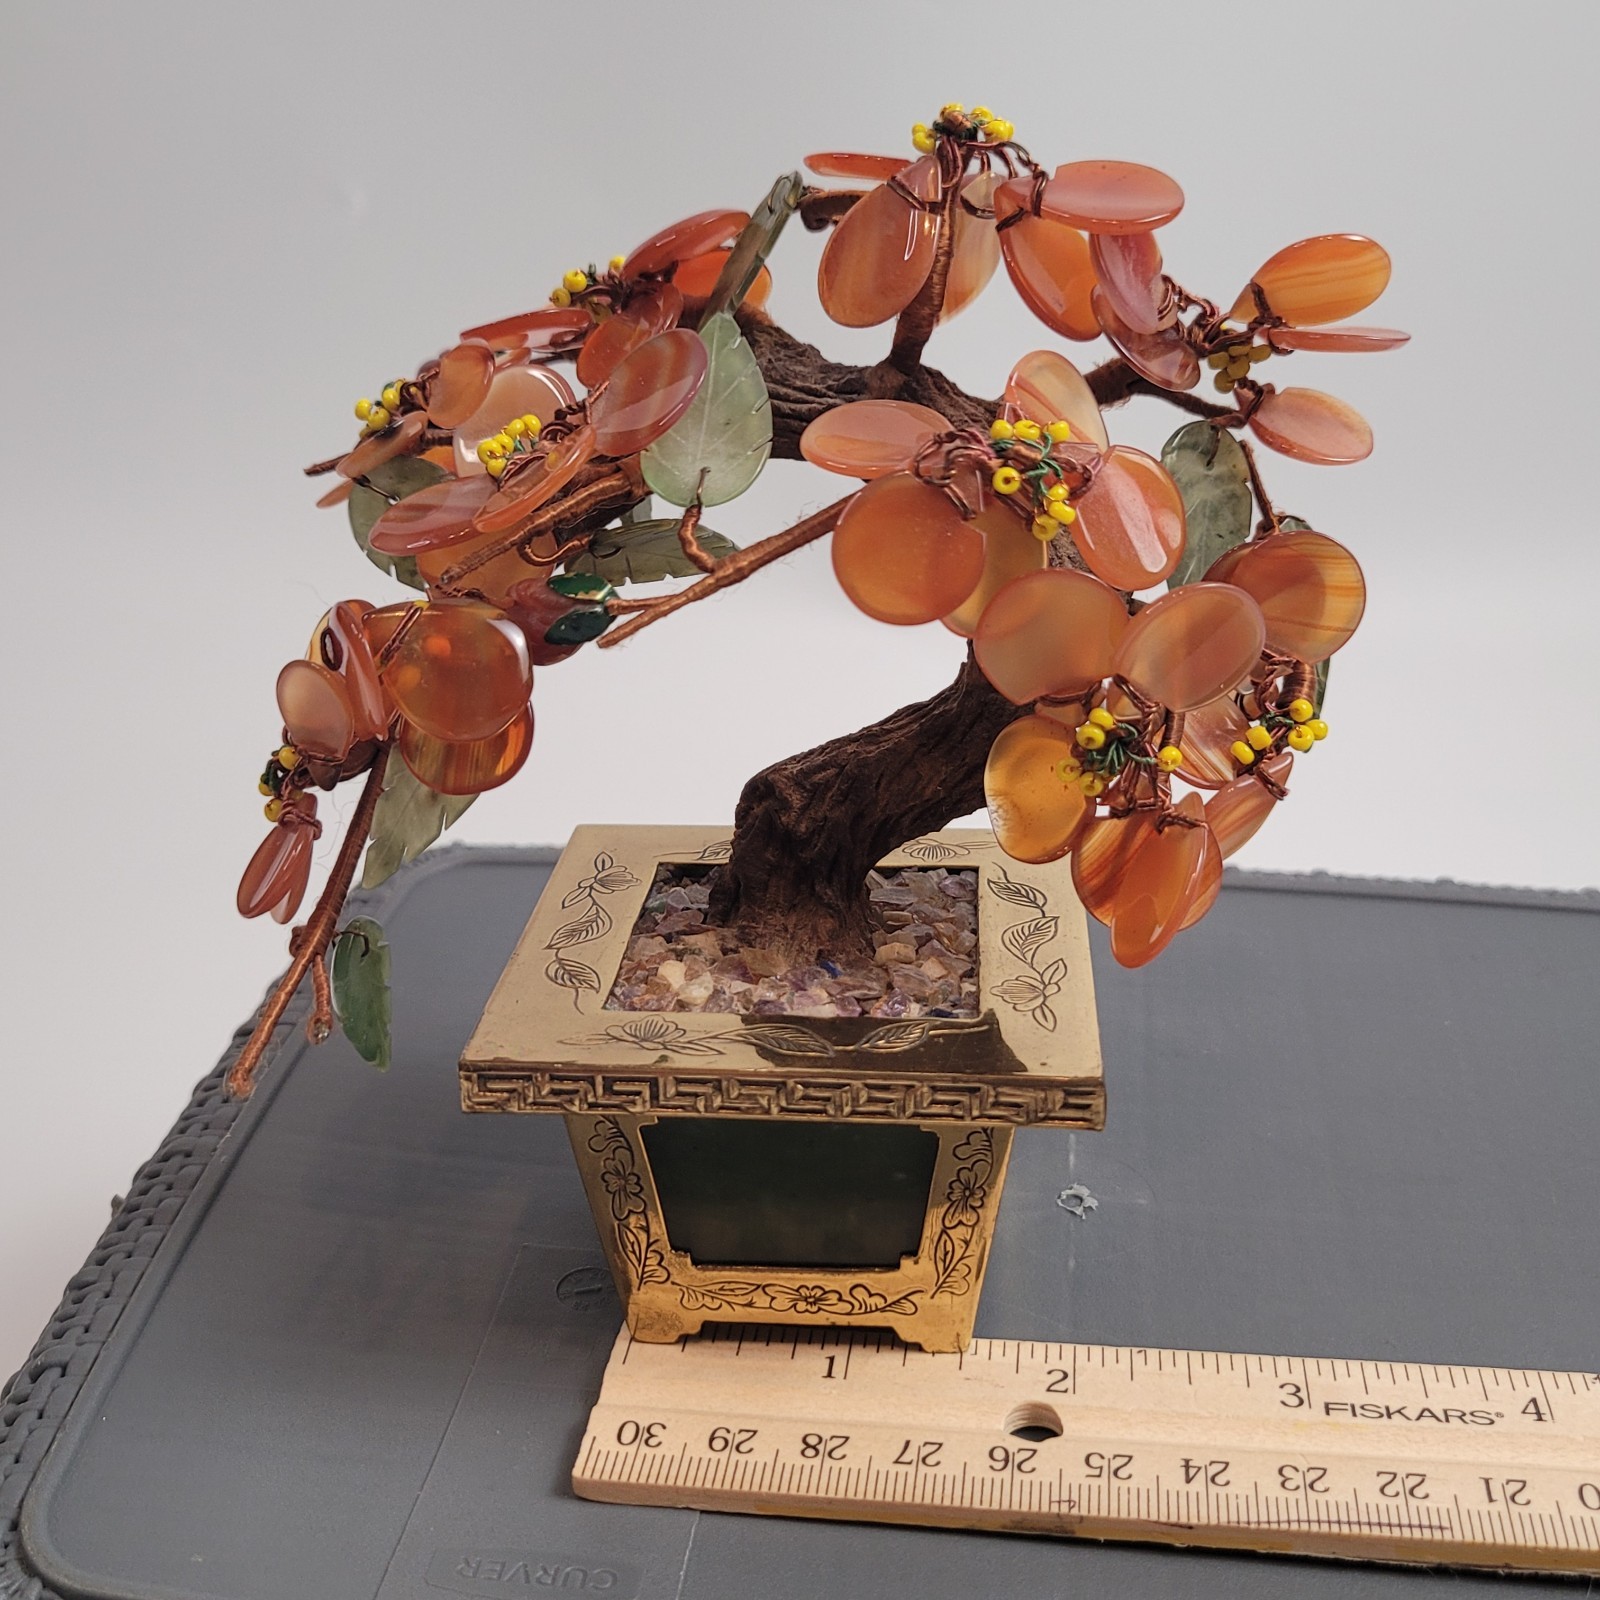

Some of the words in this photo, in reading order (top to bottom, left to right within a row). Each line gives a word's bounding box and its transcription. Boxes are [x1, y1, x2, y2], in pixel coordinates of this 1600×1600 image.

[823, 1355, 838, 1380] 1
[1045, 1368, 1070, 1394] 2
[1279, 1382, 1305, 1409] 3
[1520, 1396, 1548, 1422] 4
[616, 1419, 667, 1449] 30
[707, 1426, 759, 1455] 29
[799, 1433, 851, 1461] 28
[892, 1439, 944, 1468] 27
[987, 1445, 1039, 1474] 26
[1084, 1452, 1134, 1481] 25
[1179, 1457, 1231, 1487] 24
[1277, 1463, 1330, 1493] 23
[1376, 1470, 1431, 1500] 22
[1480, 1476, 1531, 1506] 21
[456, 1557, 618, 1590] CURVER
